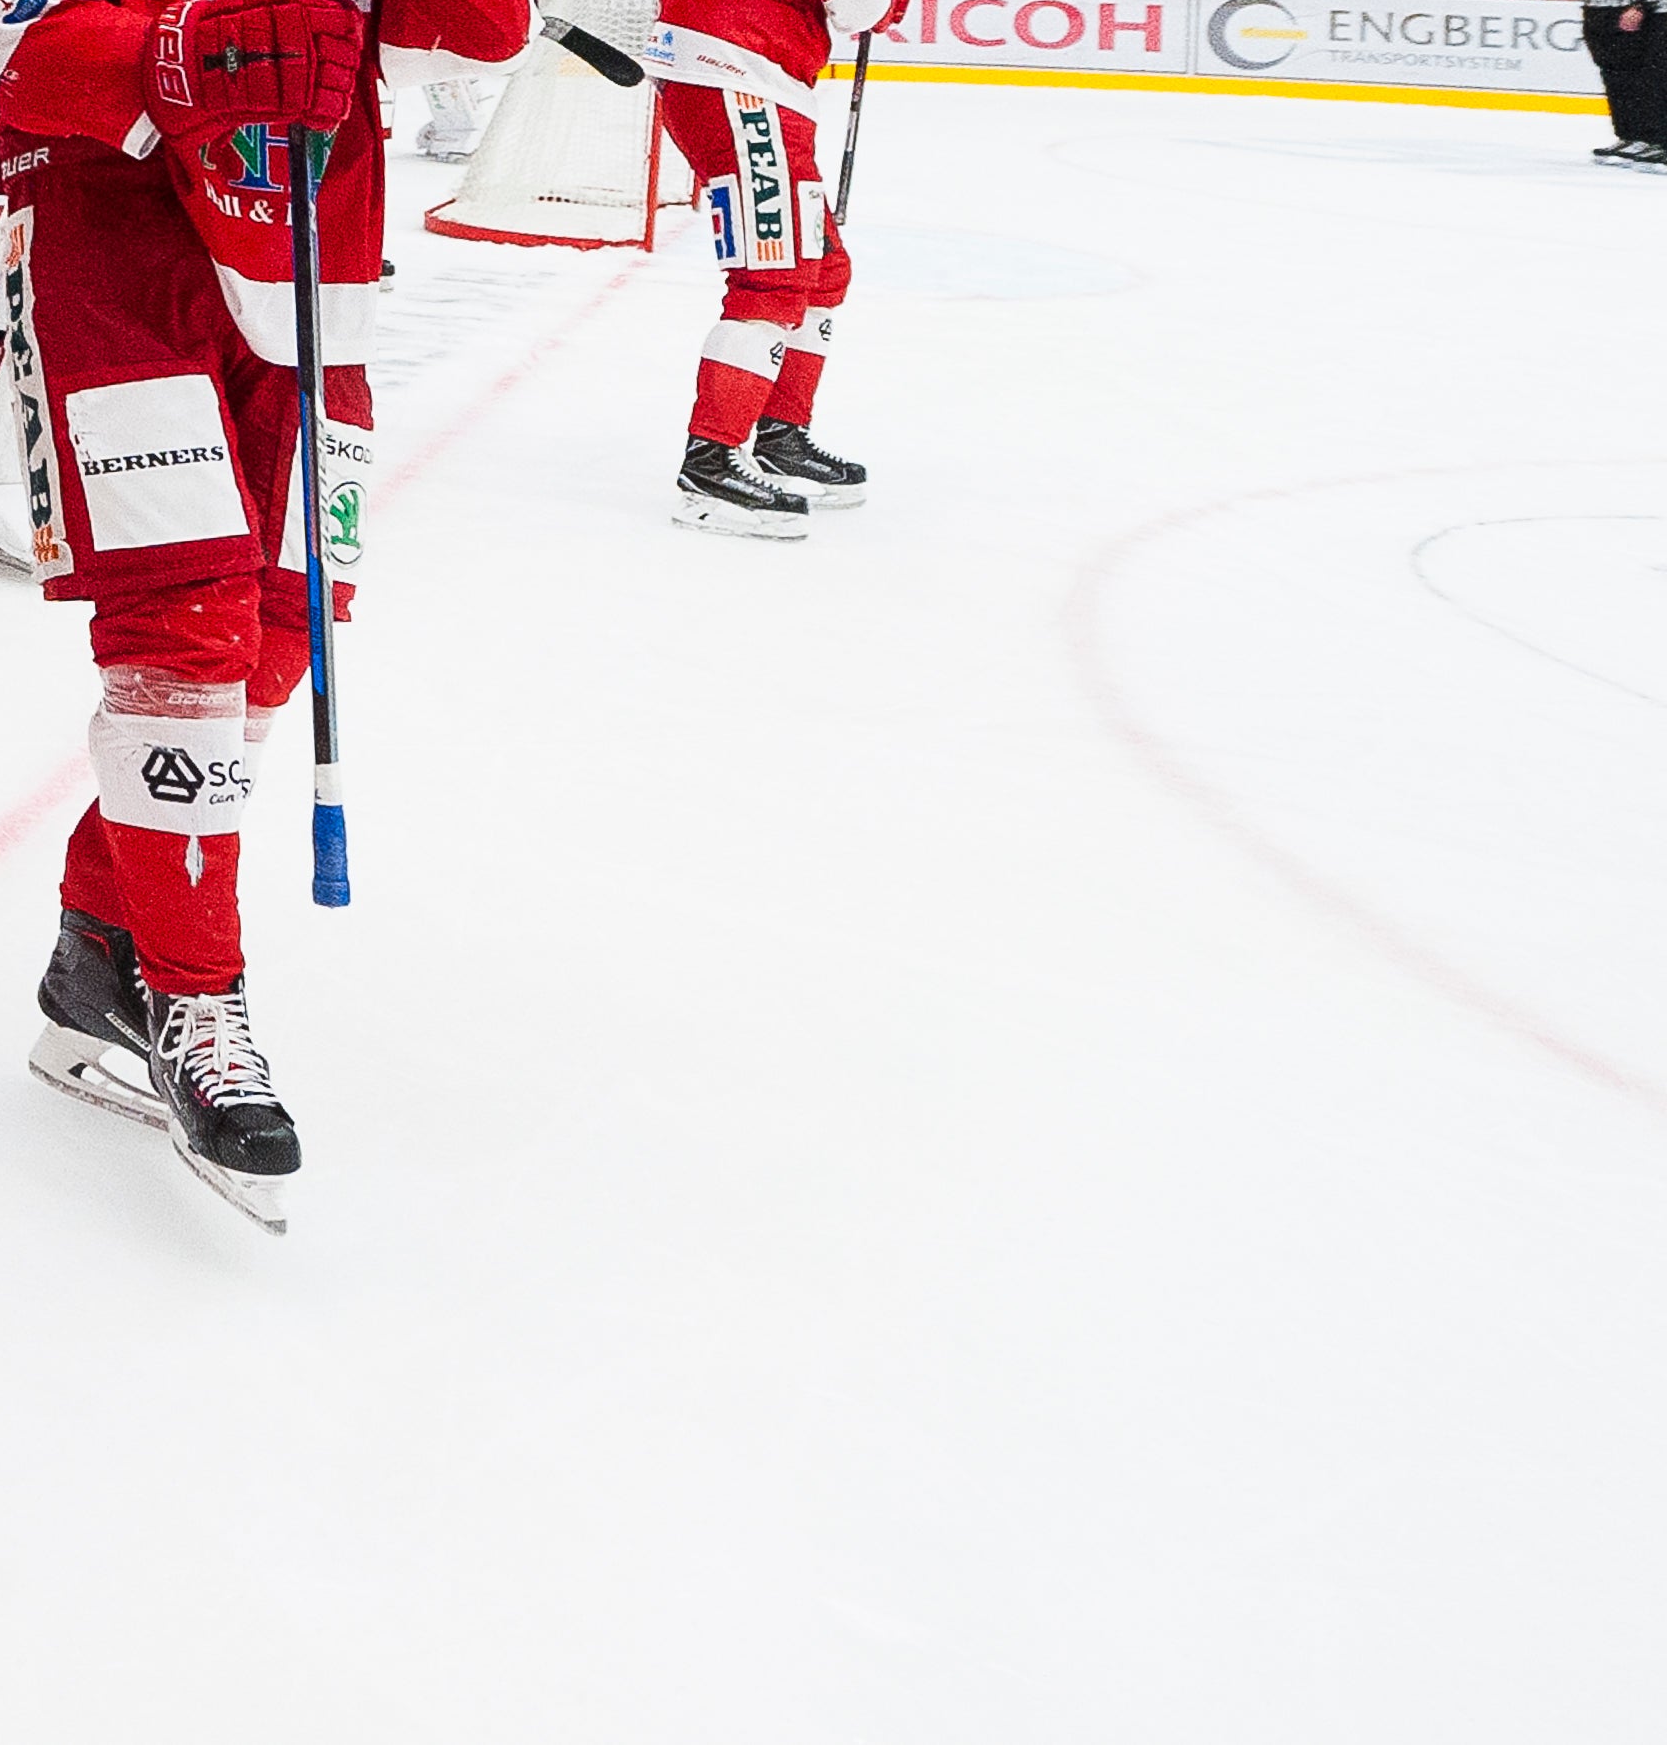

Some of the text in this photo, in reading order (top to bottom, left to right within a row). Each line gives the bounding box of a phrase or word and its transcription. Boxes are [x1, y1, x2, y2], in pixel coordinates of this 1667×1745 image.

[738, 109, 783, 241] PEAB
[83, 445, 224, 476] BERNERS
[208, 760, 241, 787] SC
